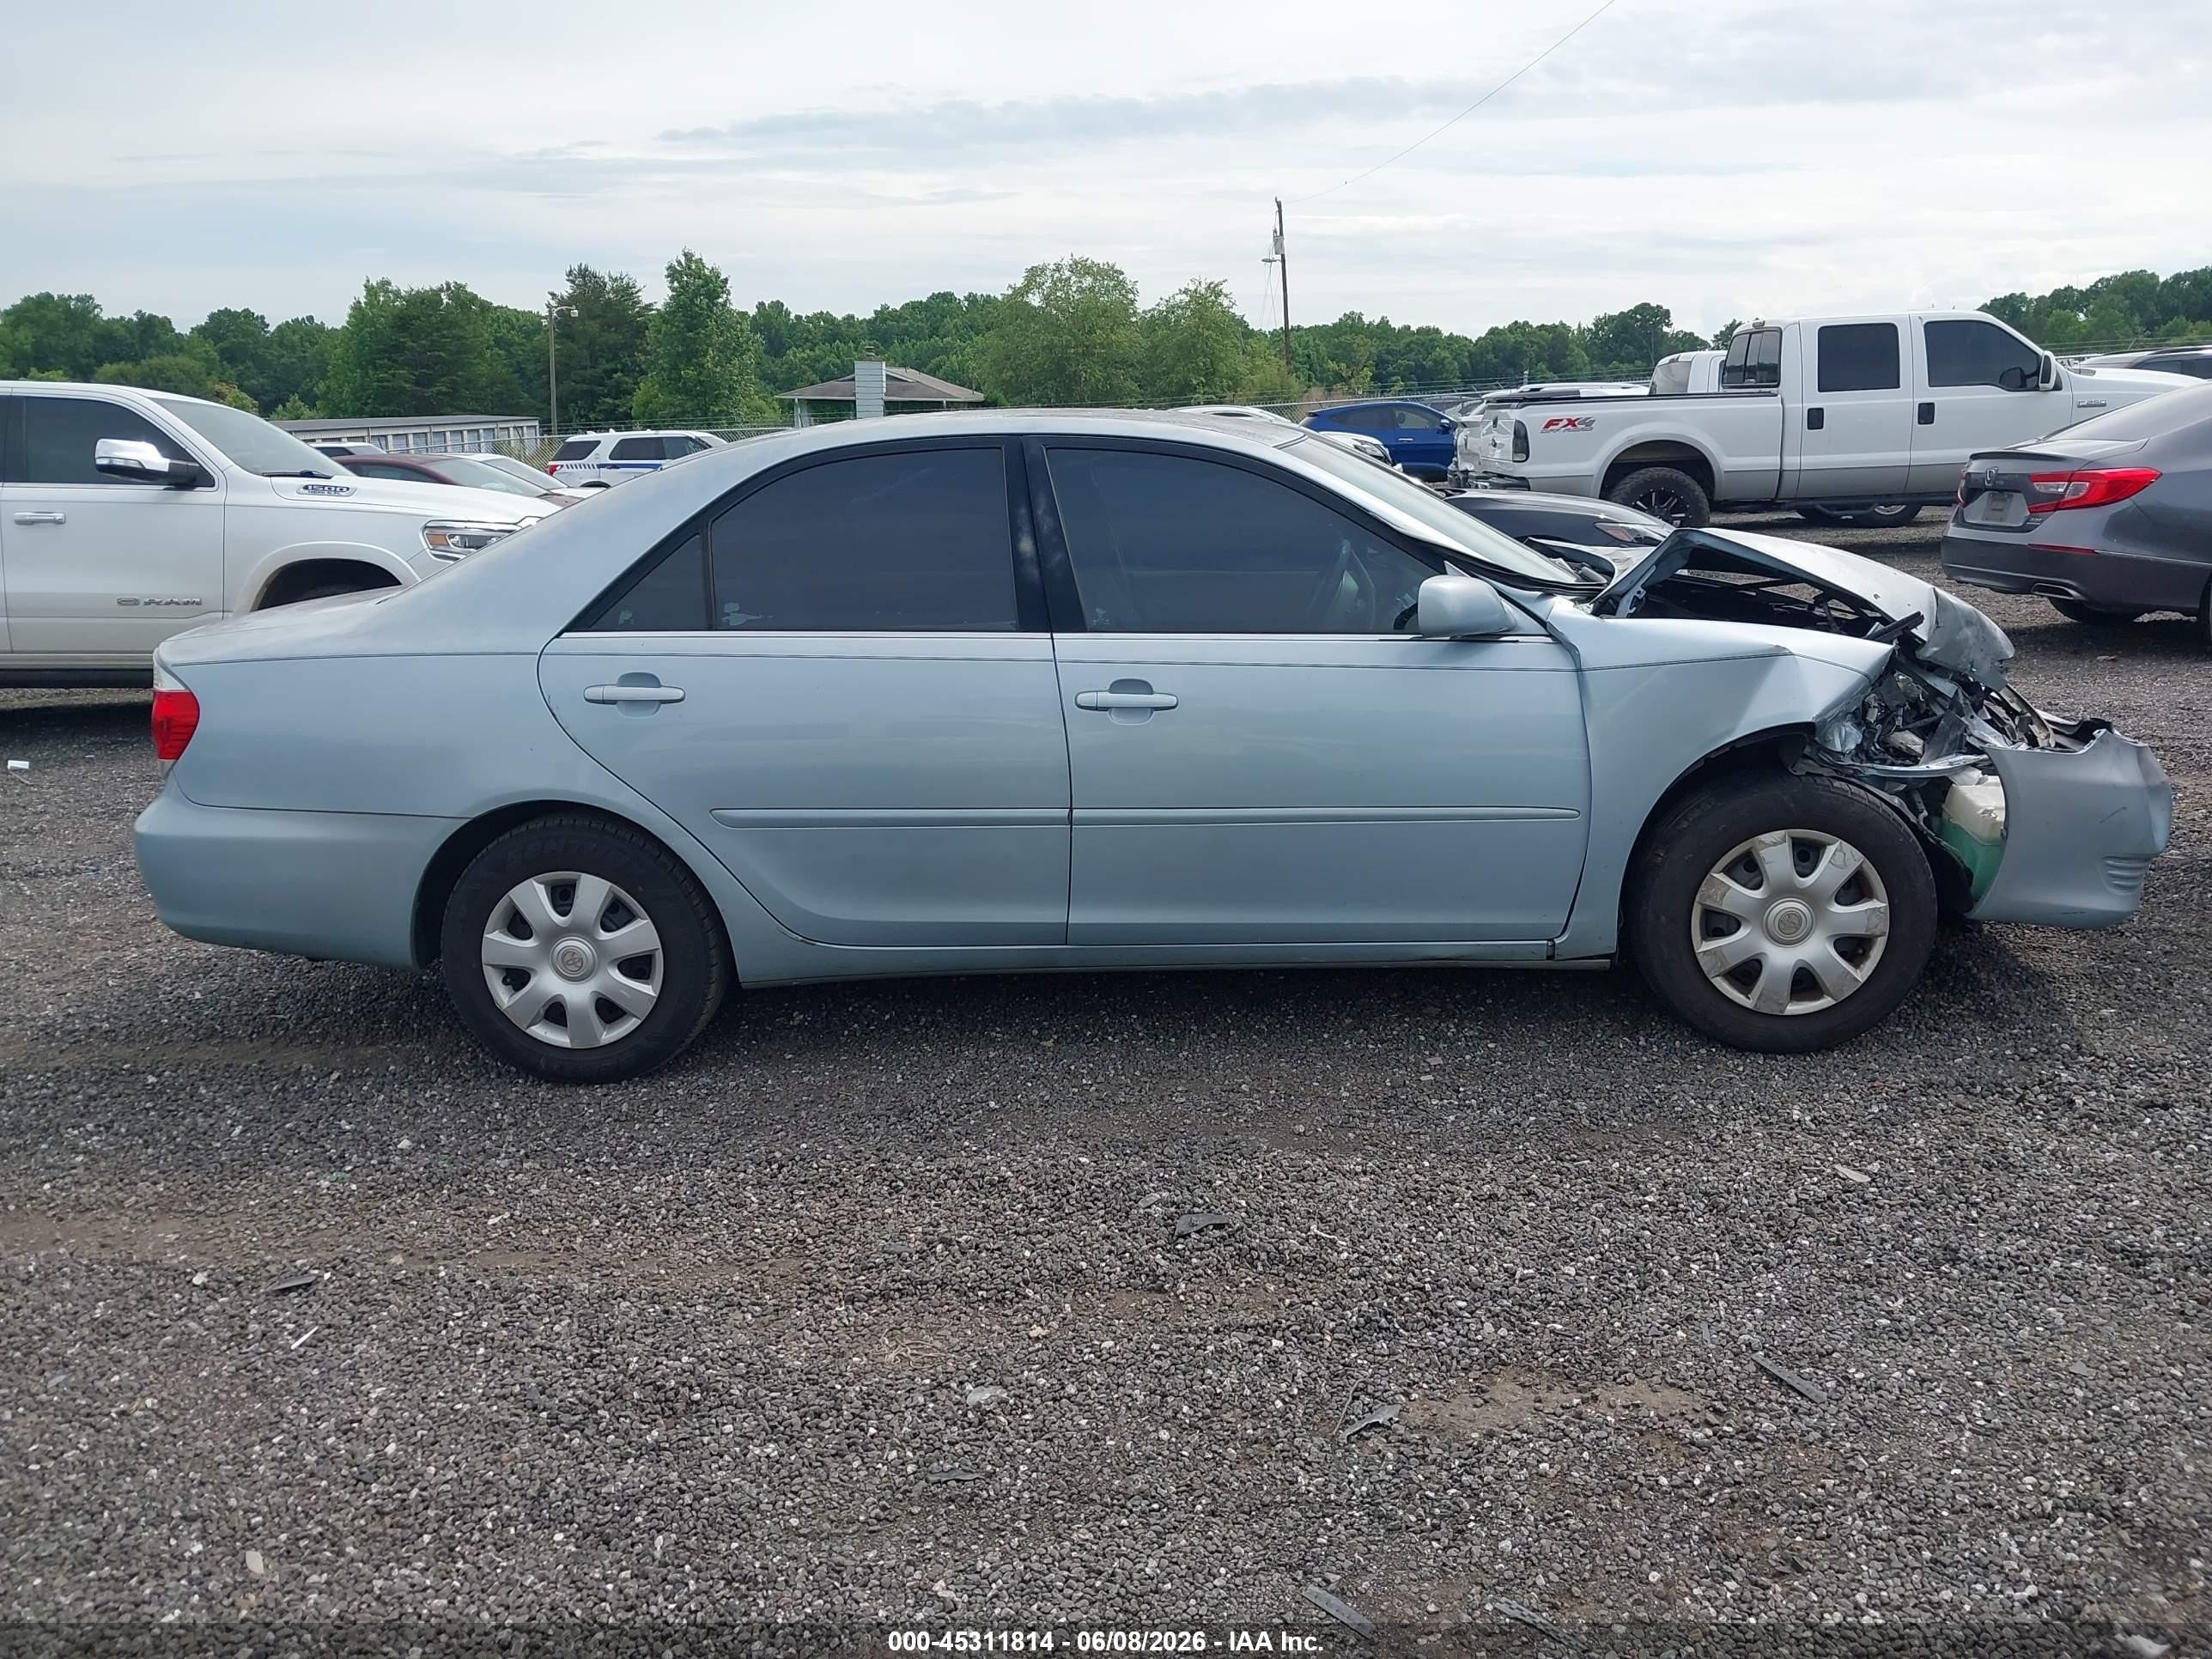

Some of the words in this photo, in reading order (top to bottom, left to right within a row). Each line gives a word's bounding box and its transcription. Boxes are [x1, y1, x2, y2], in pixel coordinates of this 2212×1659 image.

[1542, 416, 1596, 429] FX4
[307, 484, 348, 493] 1500
[143, 597, 203, 606] RAM
